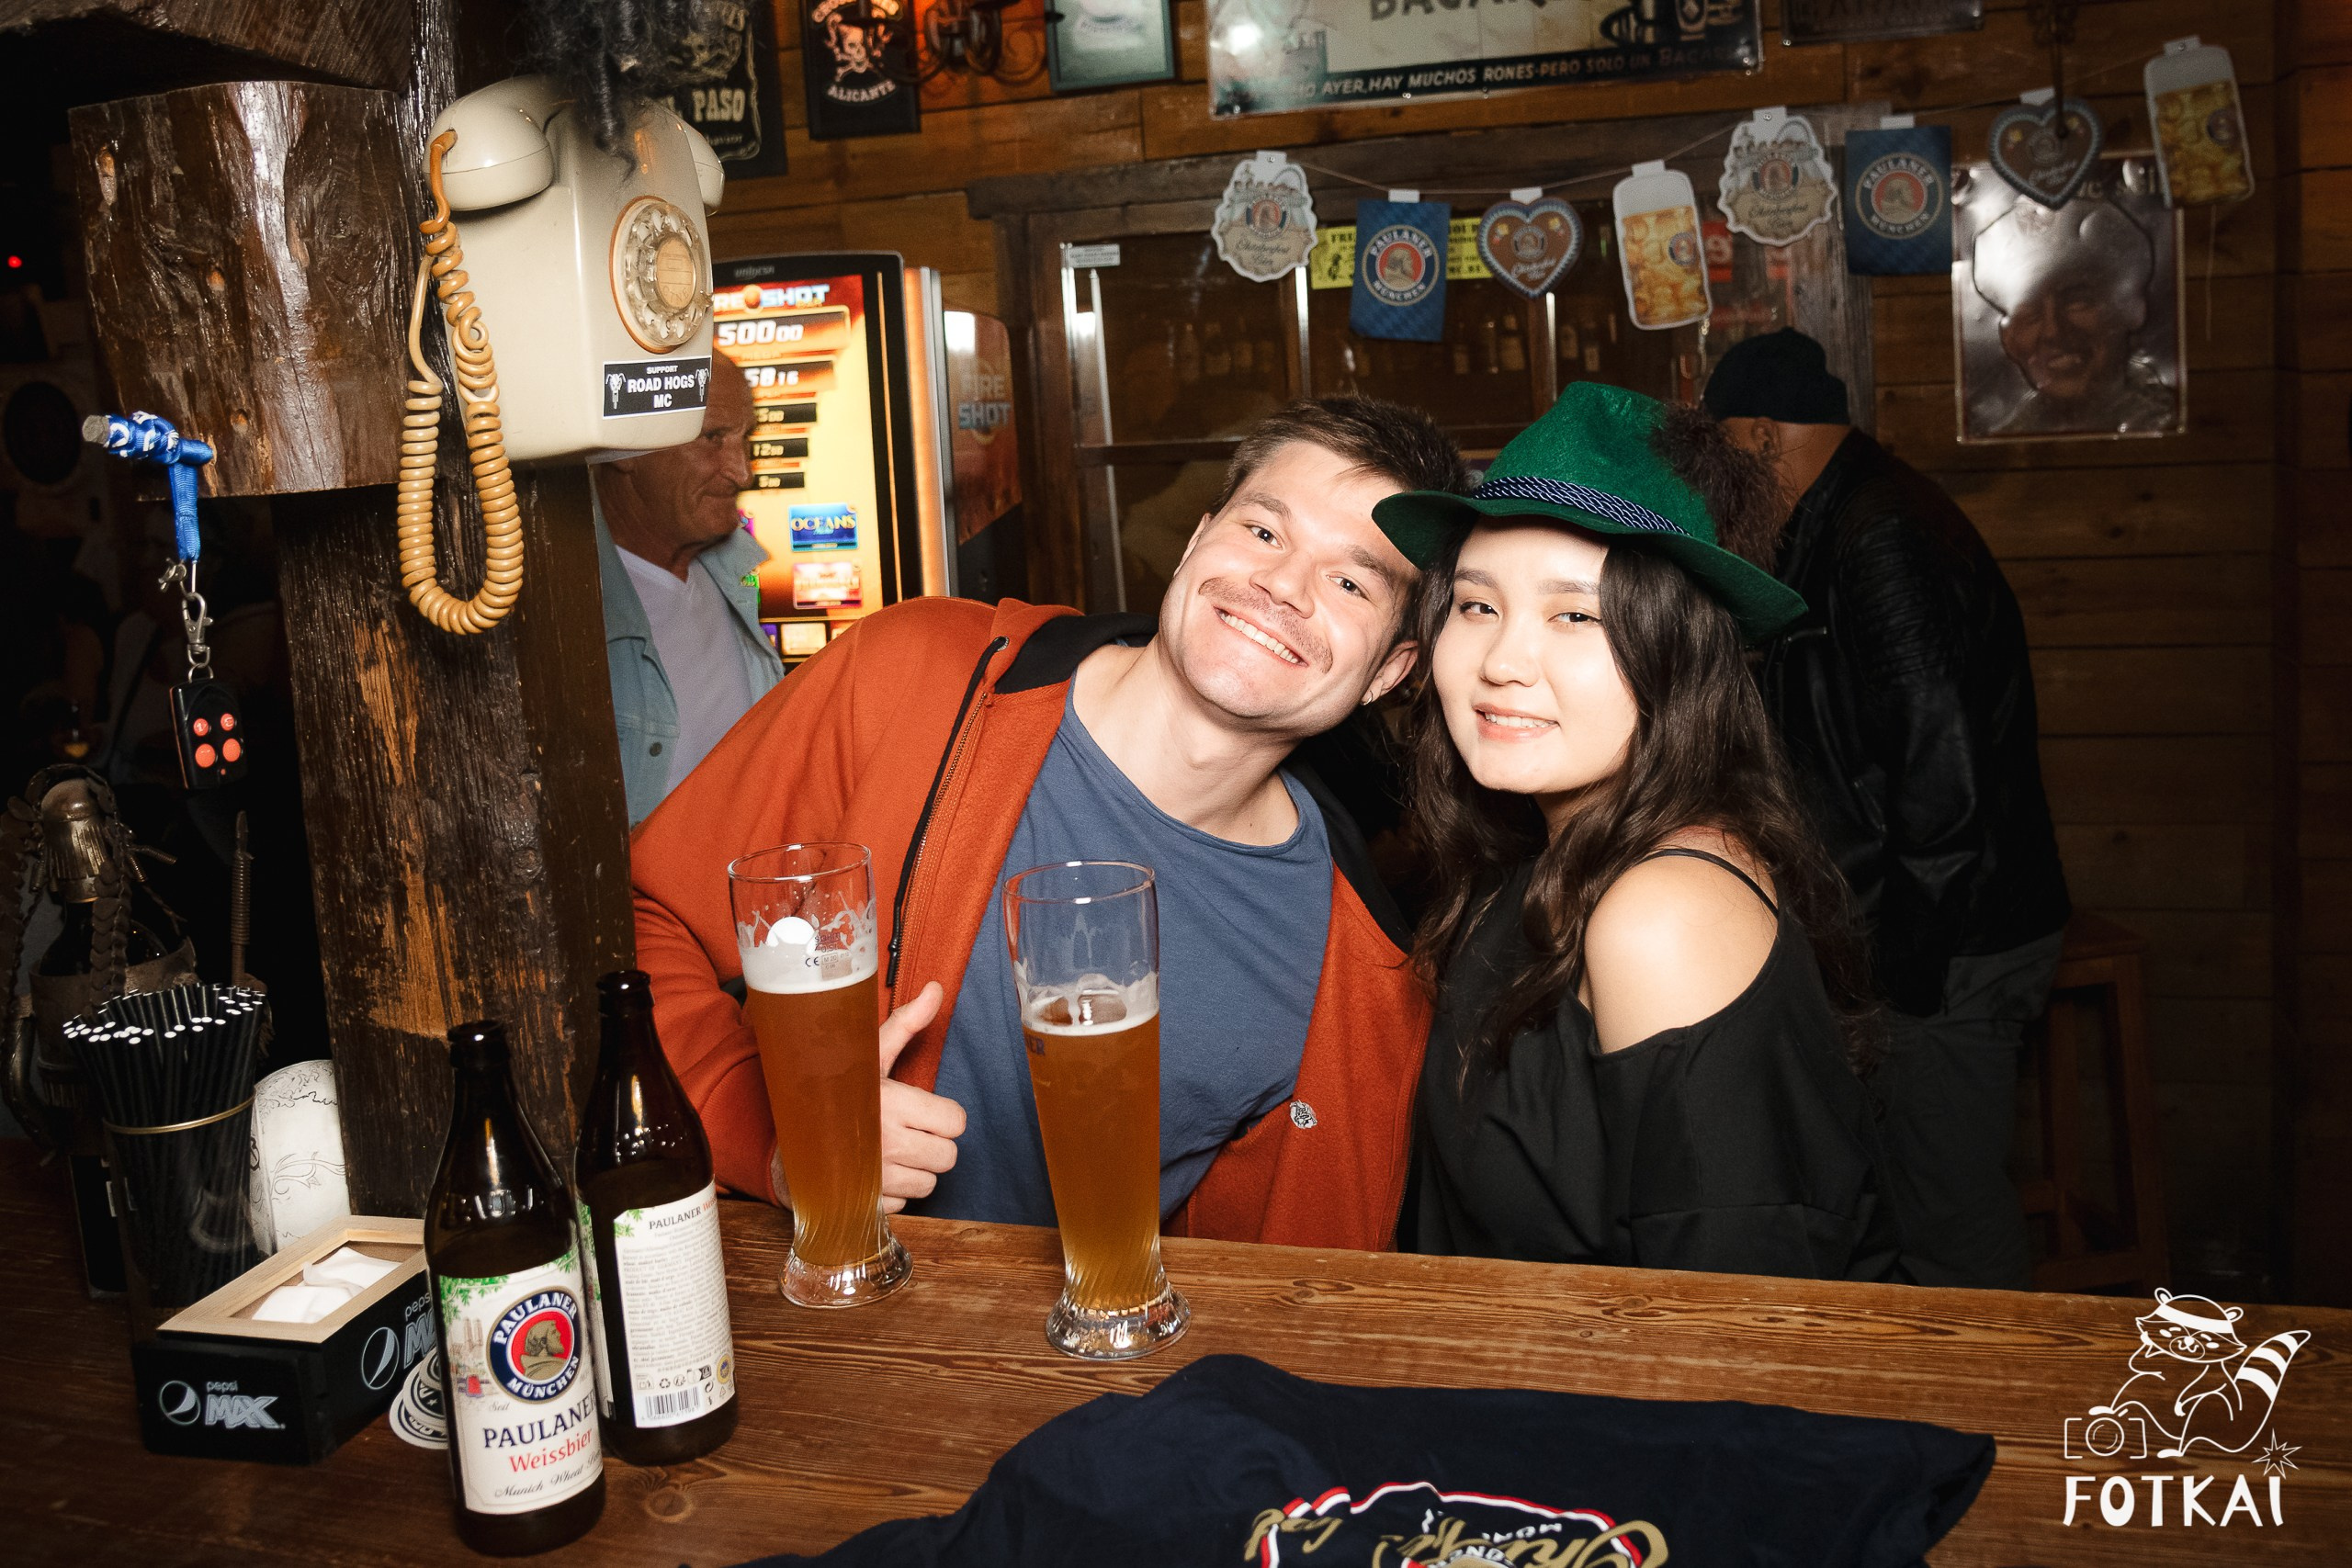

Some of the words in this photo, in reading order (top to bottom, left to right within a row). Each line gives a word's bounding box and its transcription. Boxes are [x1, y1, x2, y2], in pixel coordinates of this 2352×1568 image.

[827, 79, 897, 102] ALICANTE
[1407, 66, 1477, 89] MUCHOS
[691, 87, 746, 122] PASO
[1863, 158, 1935, 189] PAULANER
[1369, 230, 1433, 258] PAULANER
[761, 284, 831, 307] SHOT
[646, 365, 679, 375] SUPPORT
[627, 376, 662, 394] ROAD
[663, 374, 695, 390] HOGS
[653, 393, 673, 409] MC
[791, 514, 856, 531] OCEANS
[649, 1206, 702, 1230] PAULANER
[404, 1291, 432, 1321] peps
[492, 1292, 578, 1345] PAULANER
[206, 1380, 239, 1393] pepsi
[506, 1355, 580, 1399] MÜNCHEN
[205, 1393, 279, 1429] MAX
[509, 1428, 593, 1472] Weissbier
[494, 1480, 545, 1498] Munich
[550, 1463, 584, 1485] Wheat
